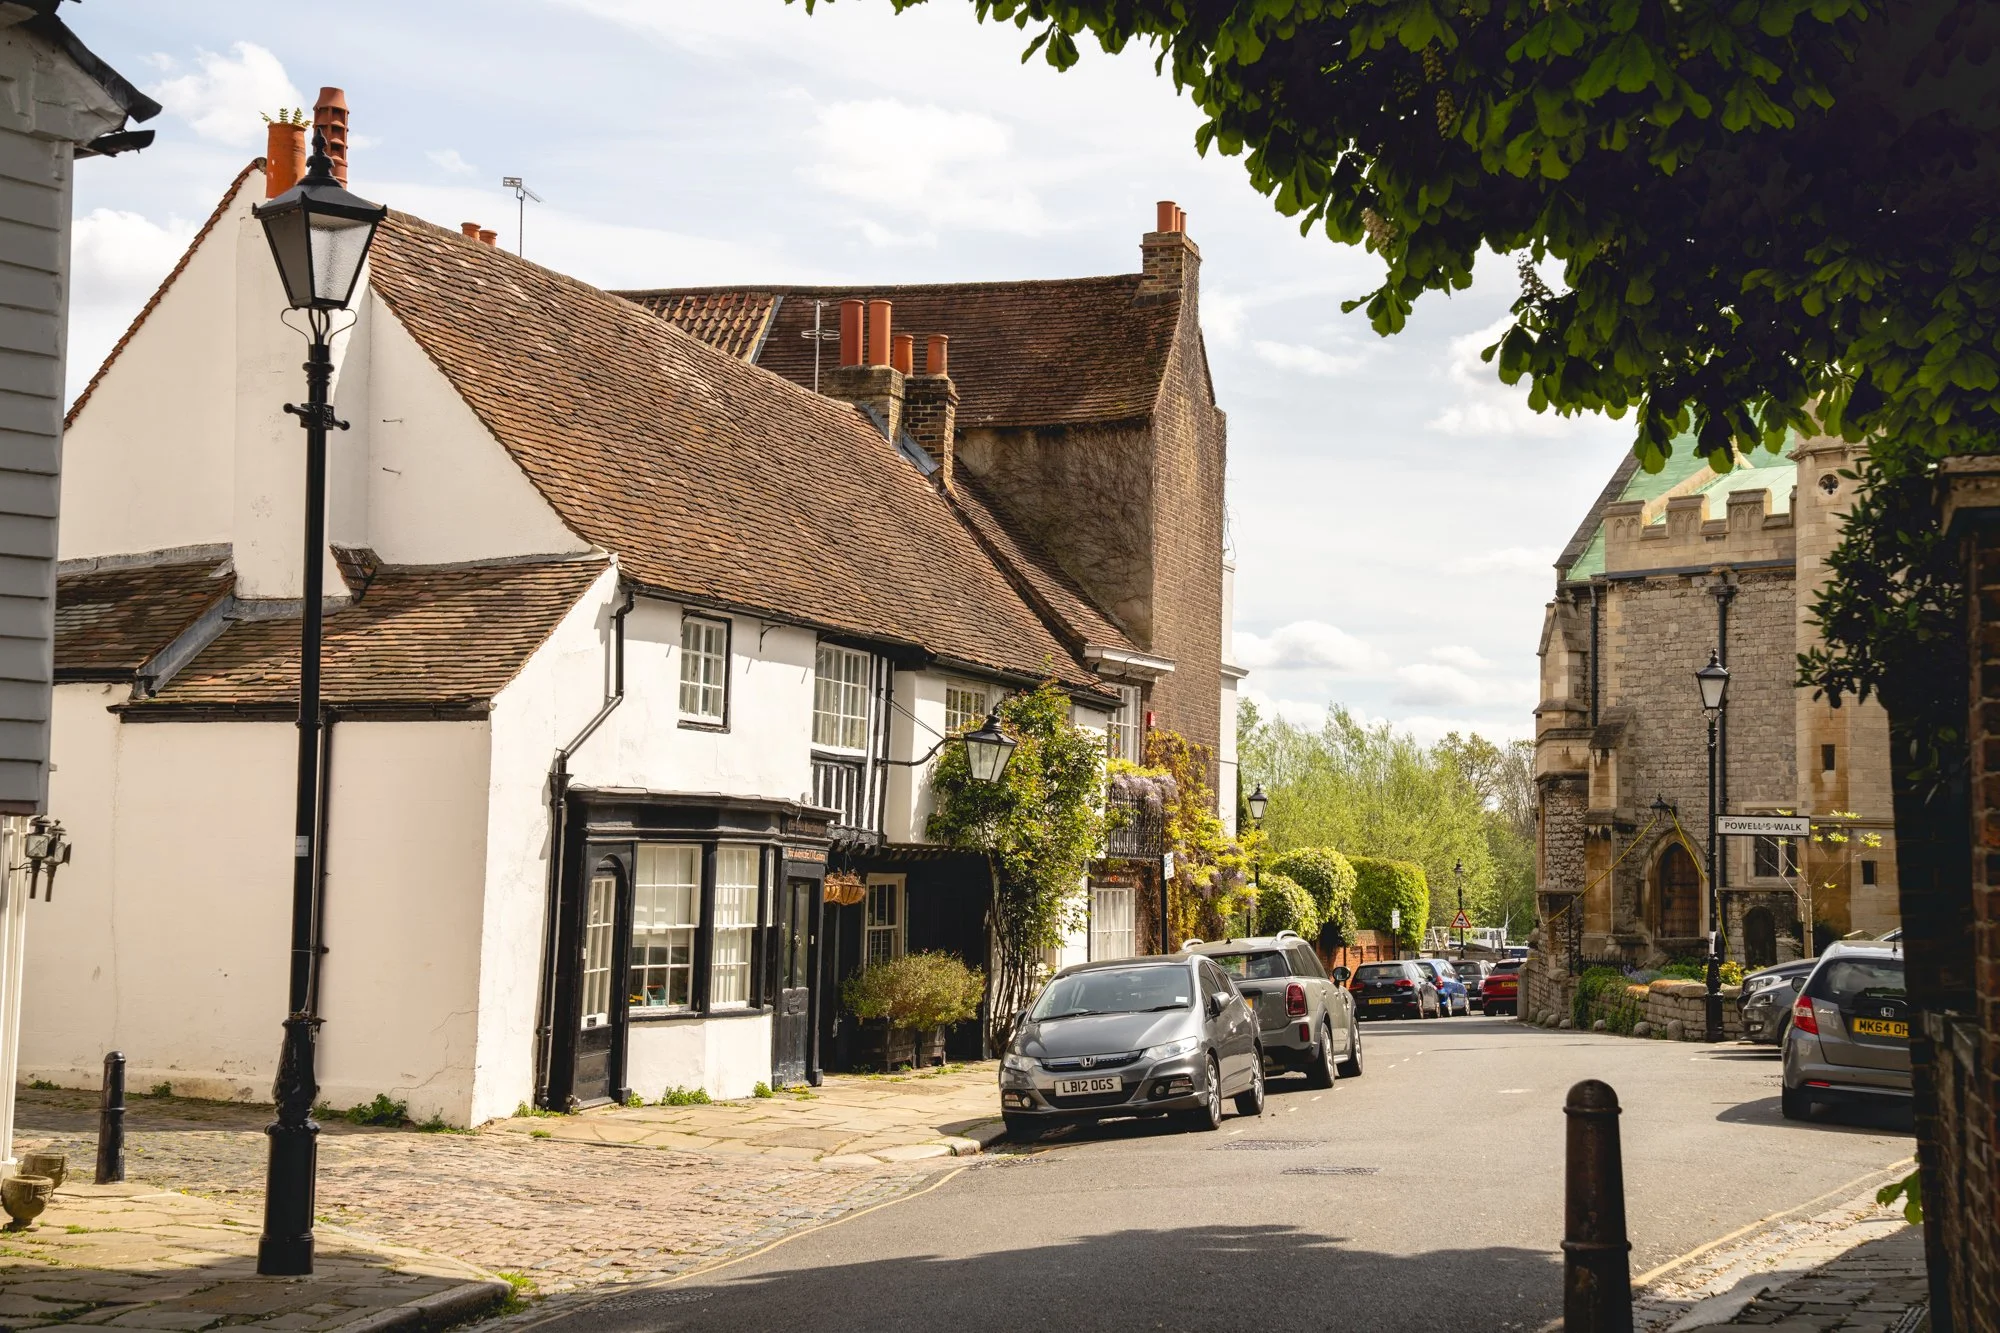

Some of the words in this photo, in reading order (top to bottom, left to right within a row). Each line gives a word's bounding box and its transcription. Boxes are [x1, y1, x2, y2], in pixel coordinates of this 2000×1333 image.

[1724, 822, 1771, 830] POWELL'S
[1774, 823, 1802, 831] WALK
[1859, 1020, 1890, 1033] MK64
[1894, 1023, 1909, 1035] OH
[1062, 1081, 1089, 1093] LB12
[1091, 1078, 1114, 1091] OGS
